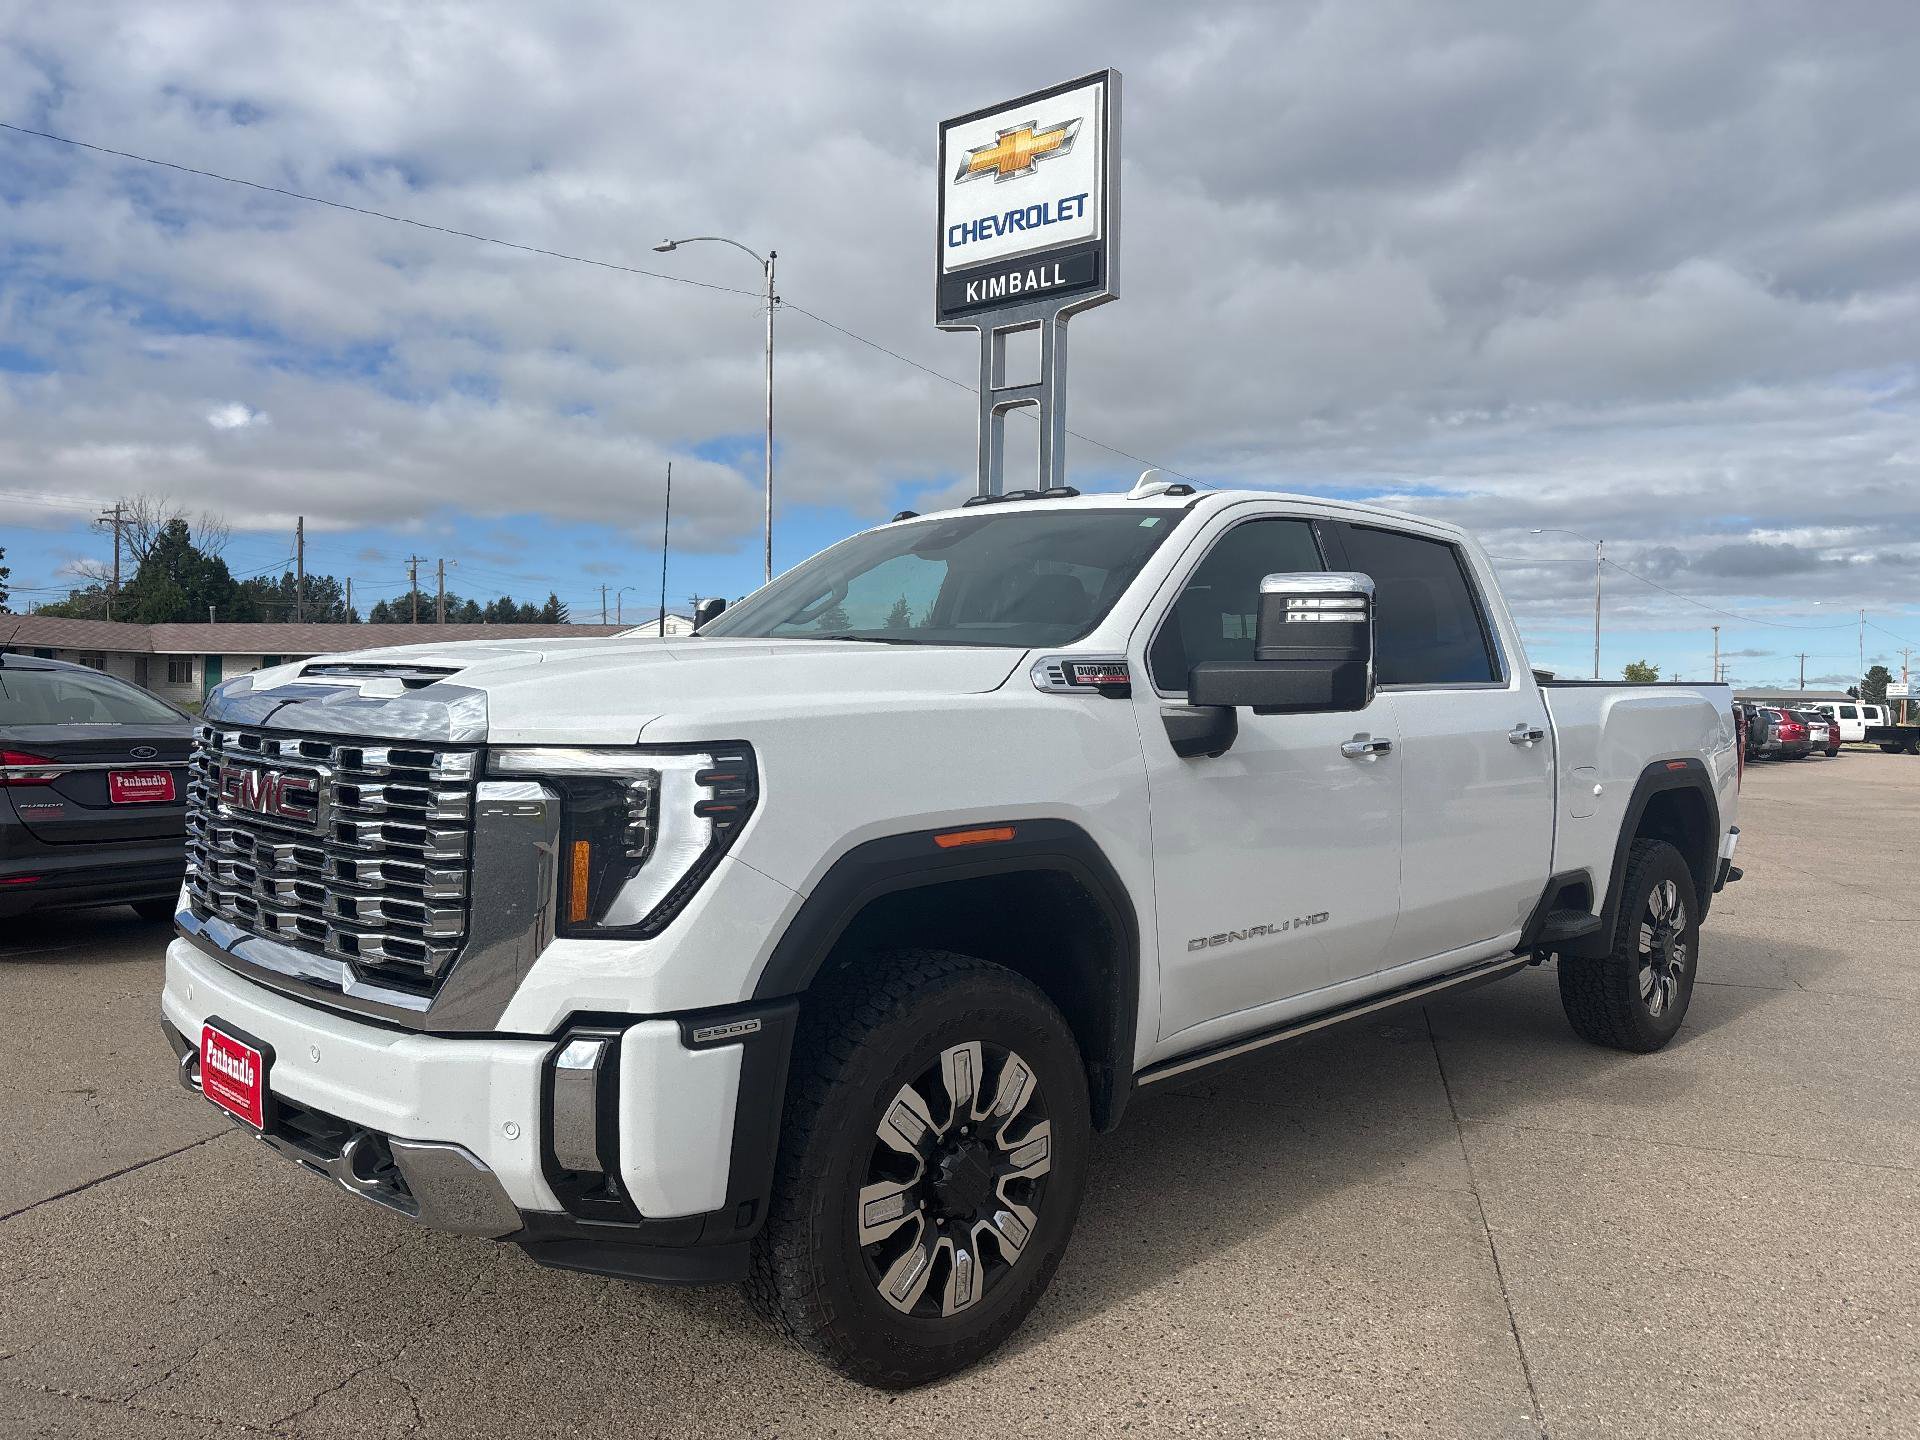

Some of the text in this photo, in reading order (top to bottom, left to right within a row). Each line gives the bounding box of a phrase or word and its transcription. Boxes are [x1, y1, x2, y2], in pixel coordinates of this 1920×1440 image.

[949, 193, 1088, 247] CHEVROLET
[966, 263, 1066, 302] KIMBALL
[1076, 666, 1124, 675] DURAMAX
[116, 775, 167, 787] Panhandle
[219, 766, 318, 823] GMC
[1188, 911, 1330, 952] DENALI HD
[697, 1022, 757, 1038] 2500
[206, 1038, 254, 1088] Panhandle
